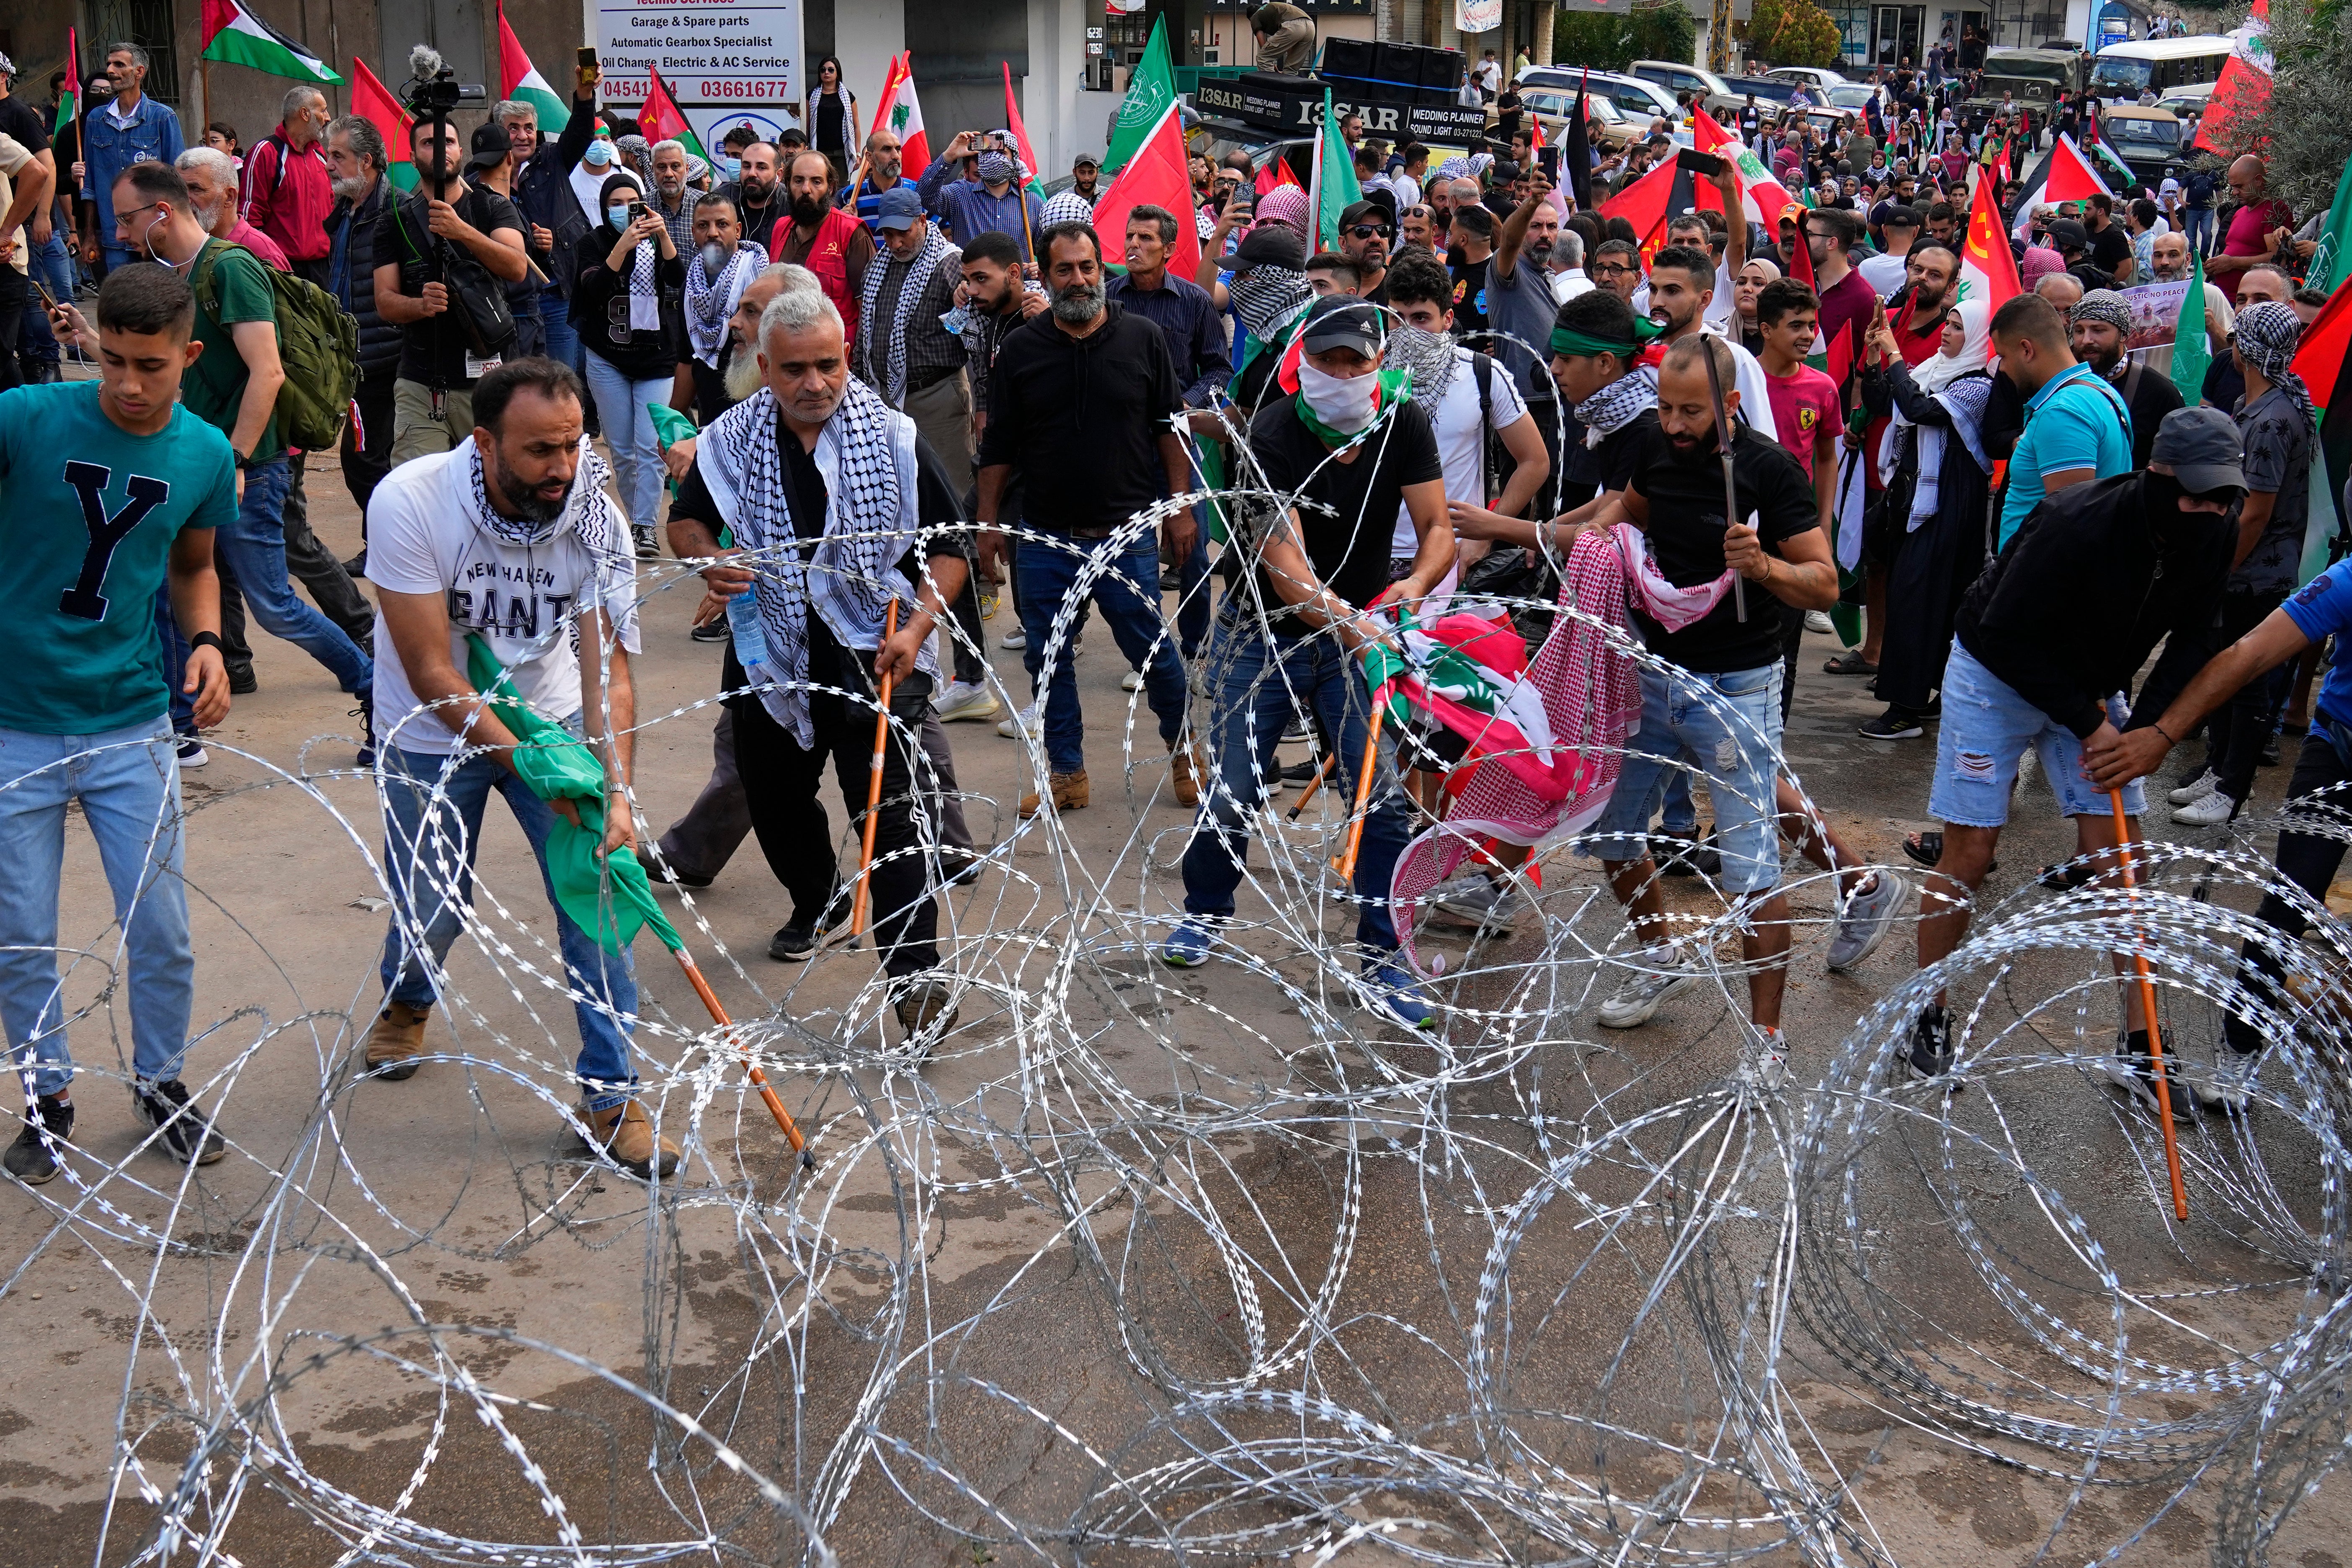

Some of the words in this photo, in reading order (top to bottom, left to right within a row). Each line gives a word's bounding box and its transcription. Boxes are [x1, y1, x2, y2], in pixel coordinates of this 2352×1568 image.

[631, 17, 669, 28] Garage
[672, 17, 680, 26] &
[683, 16, 715, 28] Spare
[719, 15, 750, 28] parts
[611, 37, 663, 48] Automatic
[665, 37, 711, 47] Gearbox
[714, 36, 772, 49] Specialist
[602, 57, 615, 68] Oil
[618, 57, 657, 70] Change
[663, 57, 707, 68] Electric
[710, 57, 720, 67] &
[722, 57, 740, 67] AC
[743, 57, 790, 68] Service
[604, 81, 678, 97] 045414
[701, 81, 787, 98] 03661677
[1246, 96, 1263, 106] WEDDING
[1263, 100, 1281, 109] PLANNER
[1413, 109, 1449, 121] WEDDING
[1450, 112, 1484, 124] PLANNER
[1410, 124, 1432, 134] SOUND
[1434, 126, 1452, 136] LIGHT
[1454, 128, 1482, 138] 03-271223
[58, 459, 170, 622] Y
[467, 562, 496, 583] NEW
[502, 567, 555, 588] HAVEN
[2294, 575, 2331, 605] 3
